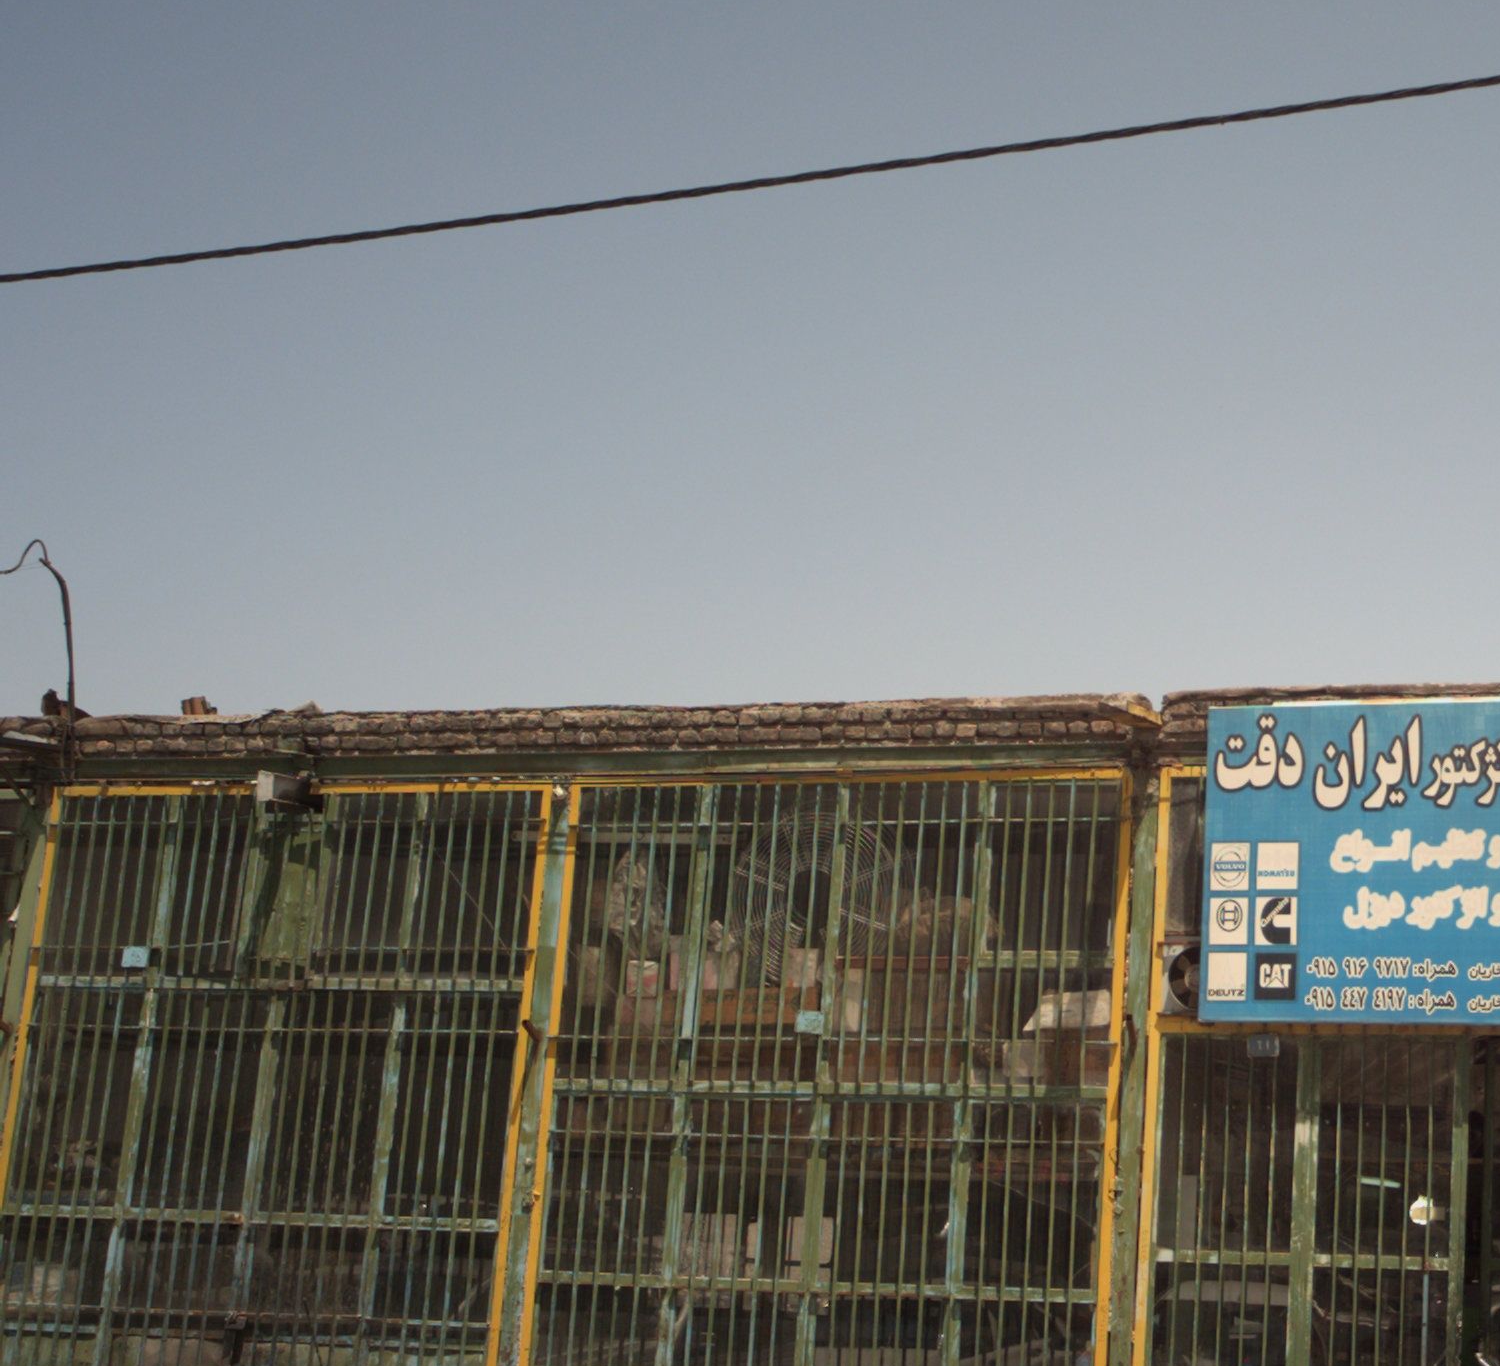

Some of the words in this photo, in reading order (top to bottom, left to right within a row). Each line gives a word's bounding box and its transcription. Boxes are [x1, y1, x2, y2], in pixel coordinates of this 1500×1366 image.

[1213, 714, 1304, 791] دقت
[1313, 714, 1421, 810] ایران
[1214, 861, 1247, 871] VOLVO
[1257, 868, 1295, 877] KOMATSU
[1259, 963, 1292, 988] CAT
[1207, 988, 1245, 997] DEUTZ
